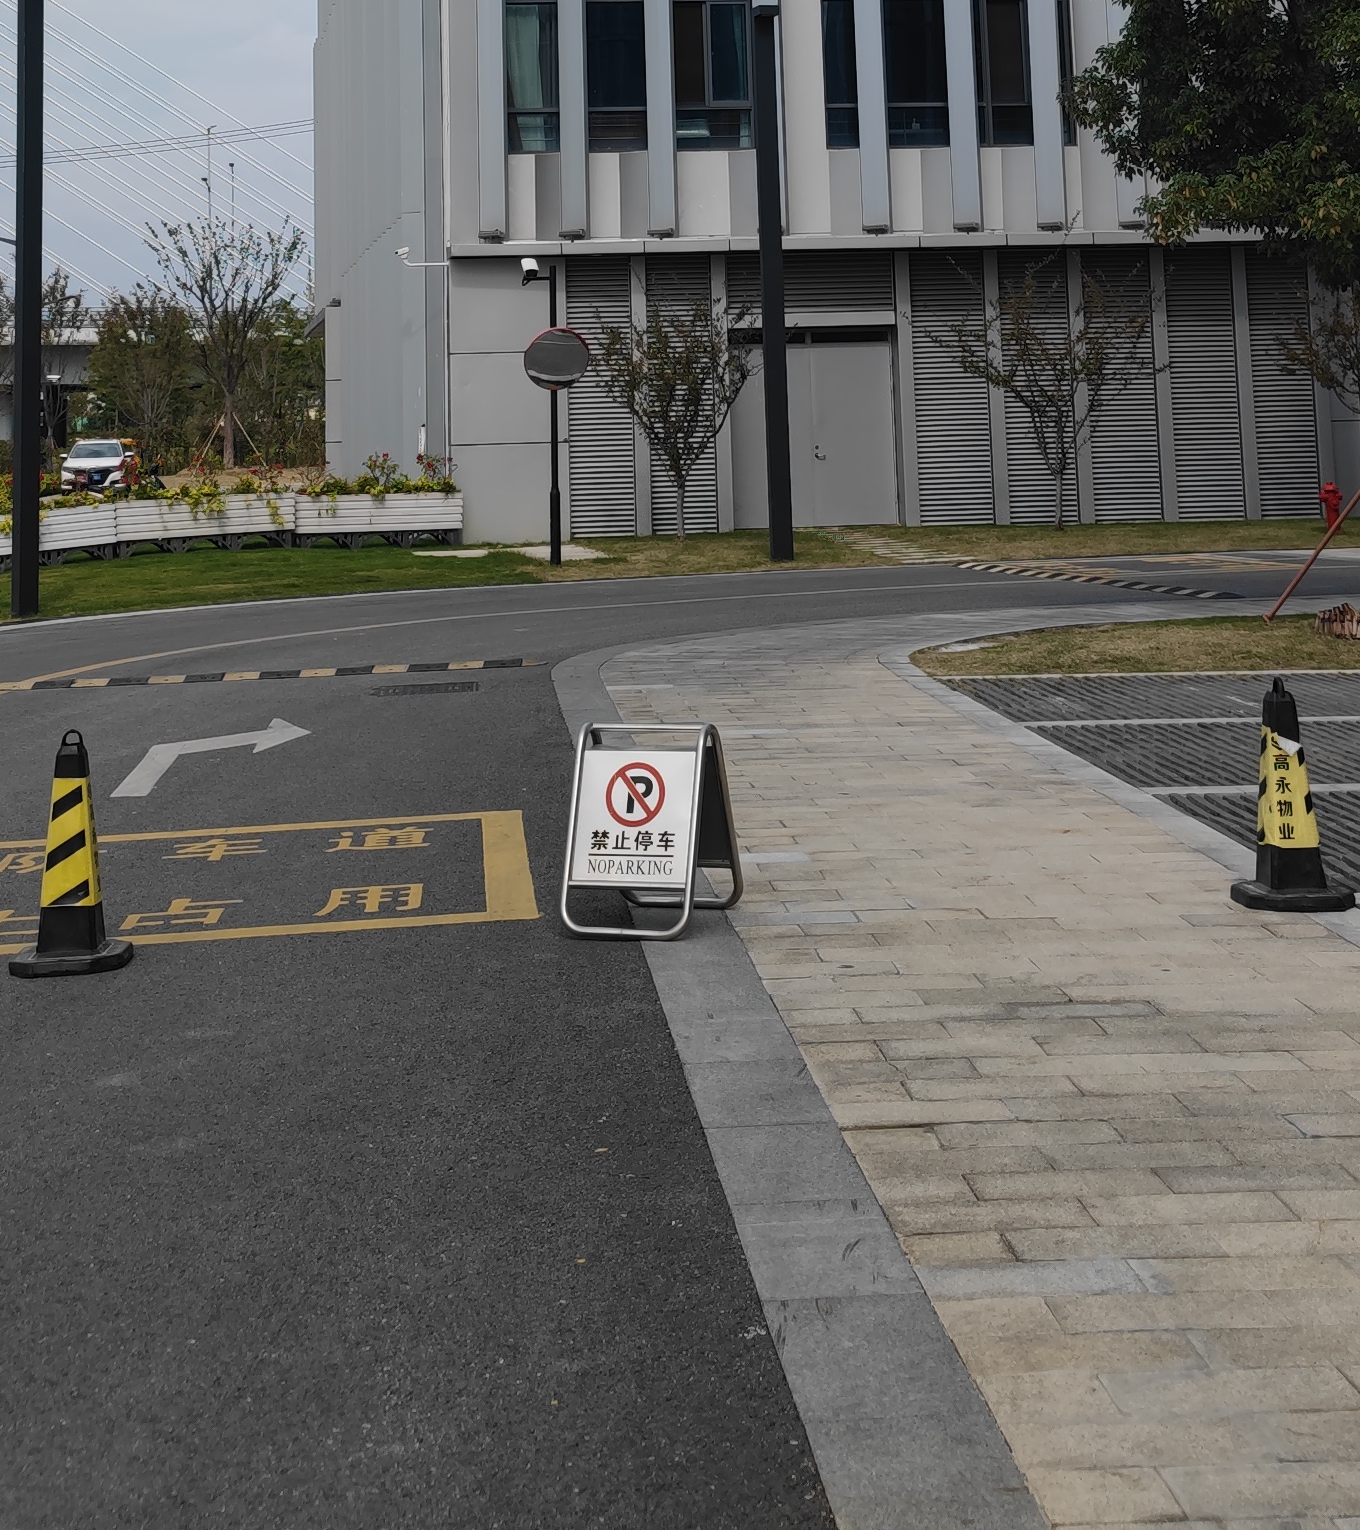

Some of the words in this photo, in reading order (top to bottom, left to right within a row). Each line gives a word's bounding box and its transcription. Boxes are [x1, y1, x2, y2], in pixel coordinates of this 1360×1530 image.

[1272, 753, 1296, 840] 高永物业
[591, 829, 675, 852] 禁止停车
[587, 858, 674, 876] NOPARKING
